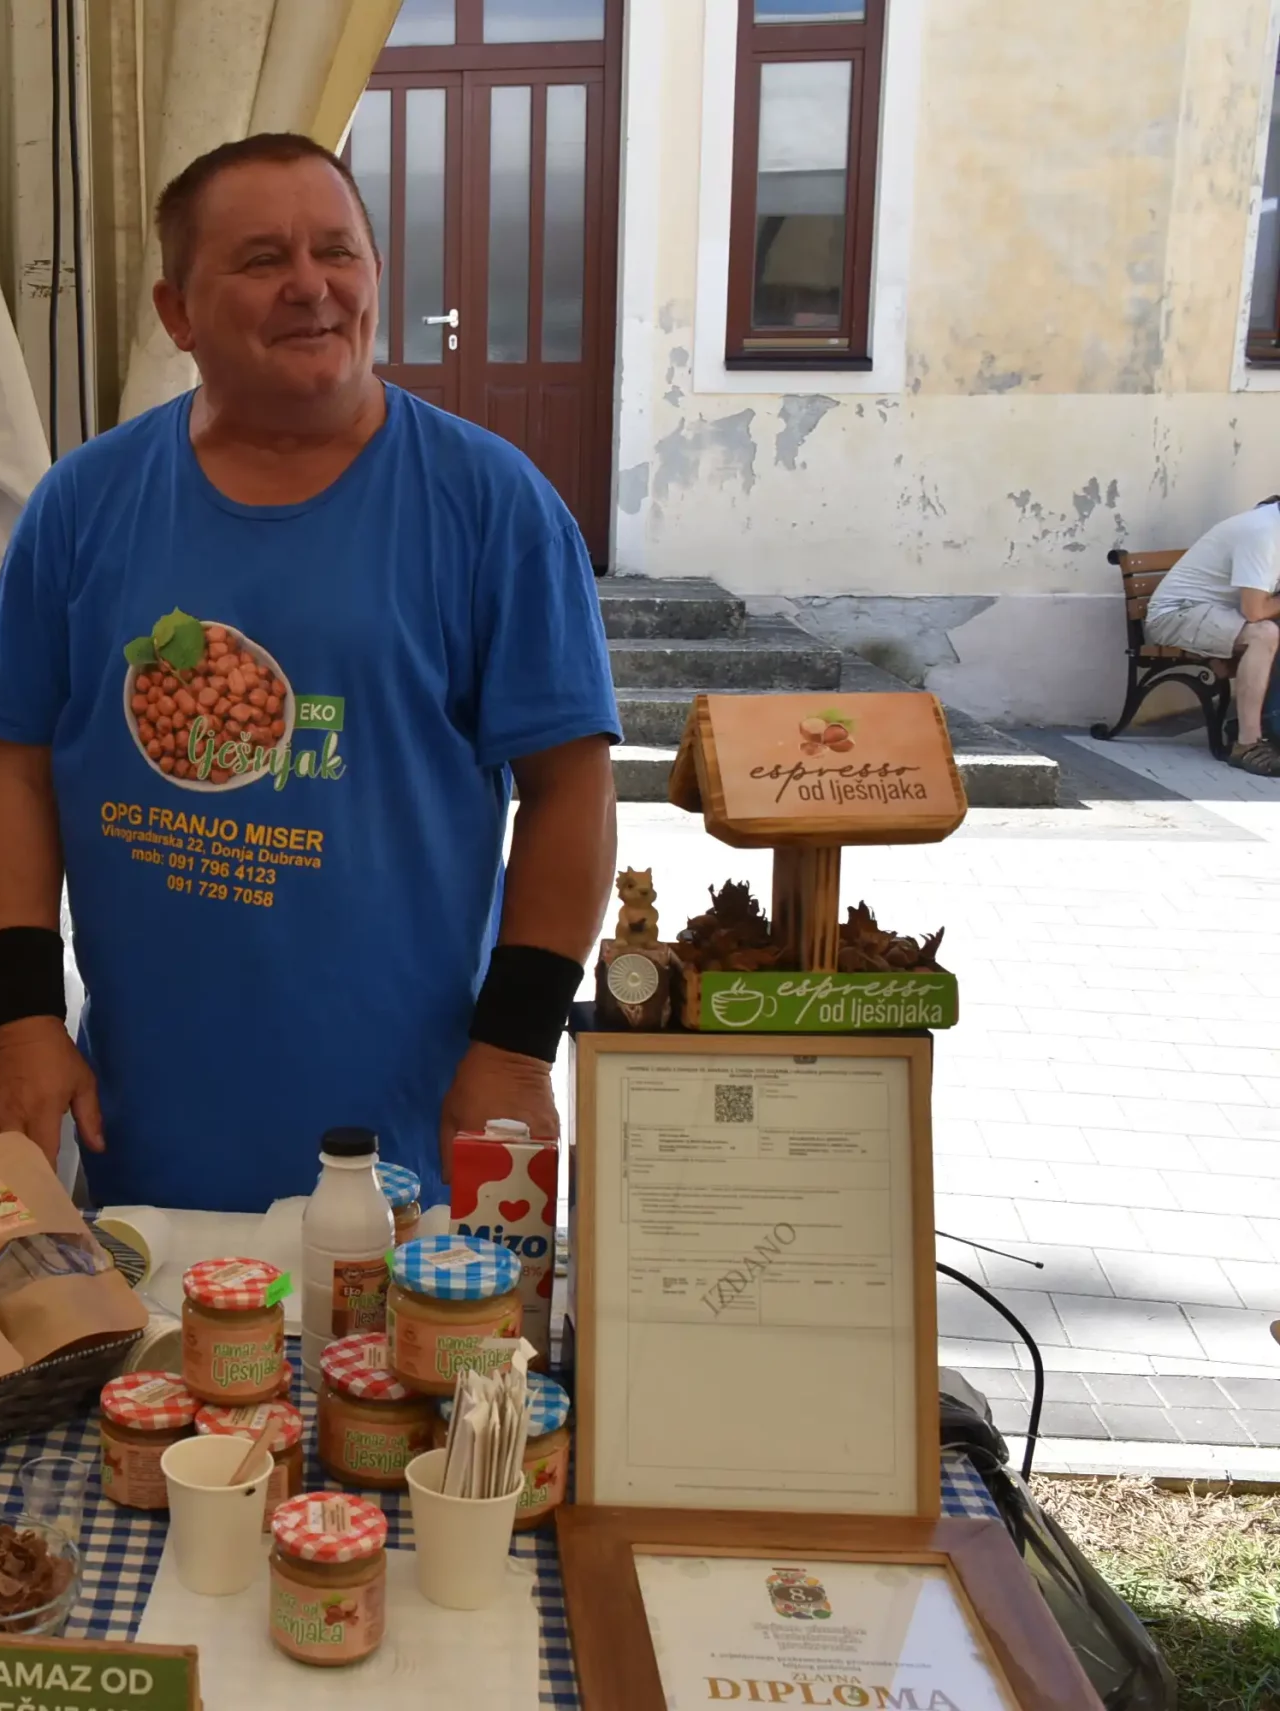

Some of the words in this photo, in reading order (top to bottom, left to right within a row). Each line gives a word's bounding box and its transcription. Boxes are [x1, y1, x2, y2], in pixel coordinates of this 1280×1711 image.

[299, 703, 336, 722] EKO
[188, 715, 347, 791] lješnjak
[750, 761, 921, 803] espresso
[799, 780, 824, 801] od
[829, 778, 927, 804] lješnjaka
[101, 801, 143, 826] OPG
[148, 807, 238, 842] FRANJO
[244, 823, 324, 852] MISER
[131, 848, 165, 865] mob:
[168, 852, 195, 871] 091
[201, 858, 230, 878] 796
[234, 865, 276, 885] 4123
[186, 837, 207, 855] 22,
[211, 841, 254, 862] Donja
[258, 848, 322, 869] Dubrava
[167, 874, 193, 894] 091
[198, 880, 228, 900] 729
[233, 886, 274, 907] 7058
[777, 976, 944, 1025] espresso
[819, 998, 842, 1023] od
[850, 997, 943, 1027] lješnjaka
[457, 1223, 548, 1258] Mizo
[699, 1222, 797, 1319] IZDANO
[213, 1342, 256, 1358] namaz
[100, 1667, 154, 1696] OD
[703, 1676, 962, 1711] DIPLOMA
[791, 1672, 861, 1685] ZLATNA
